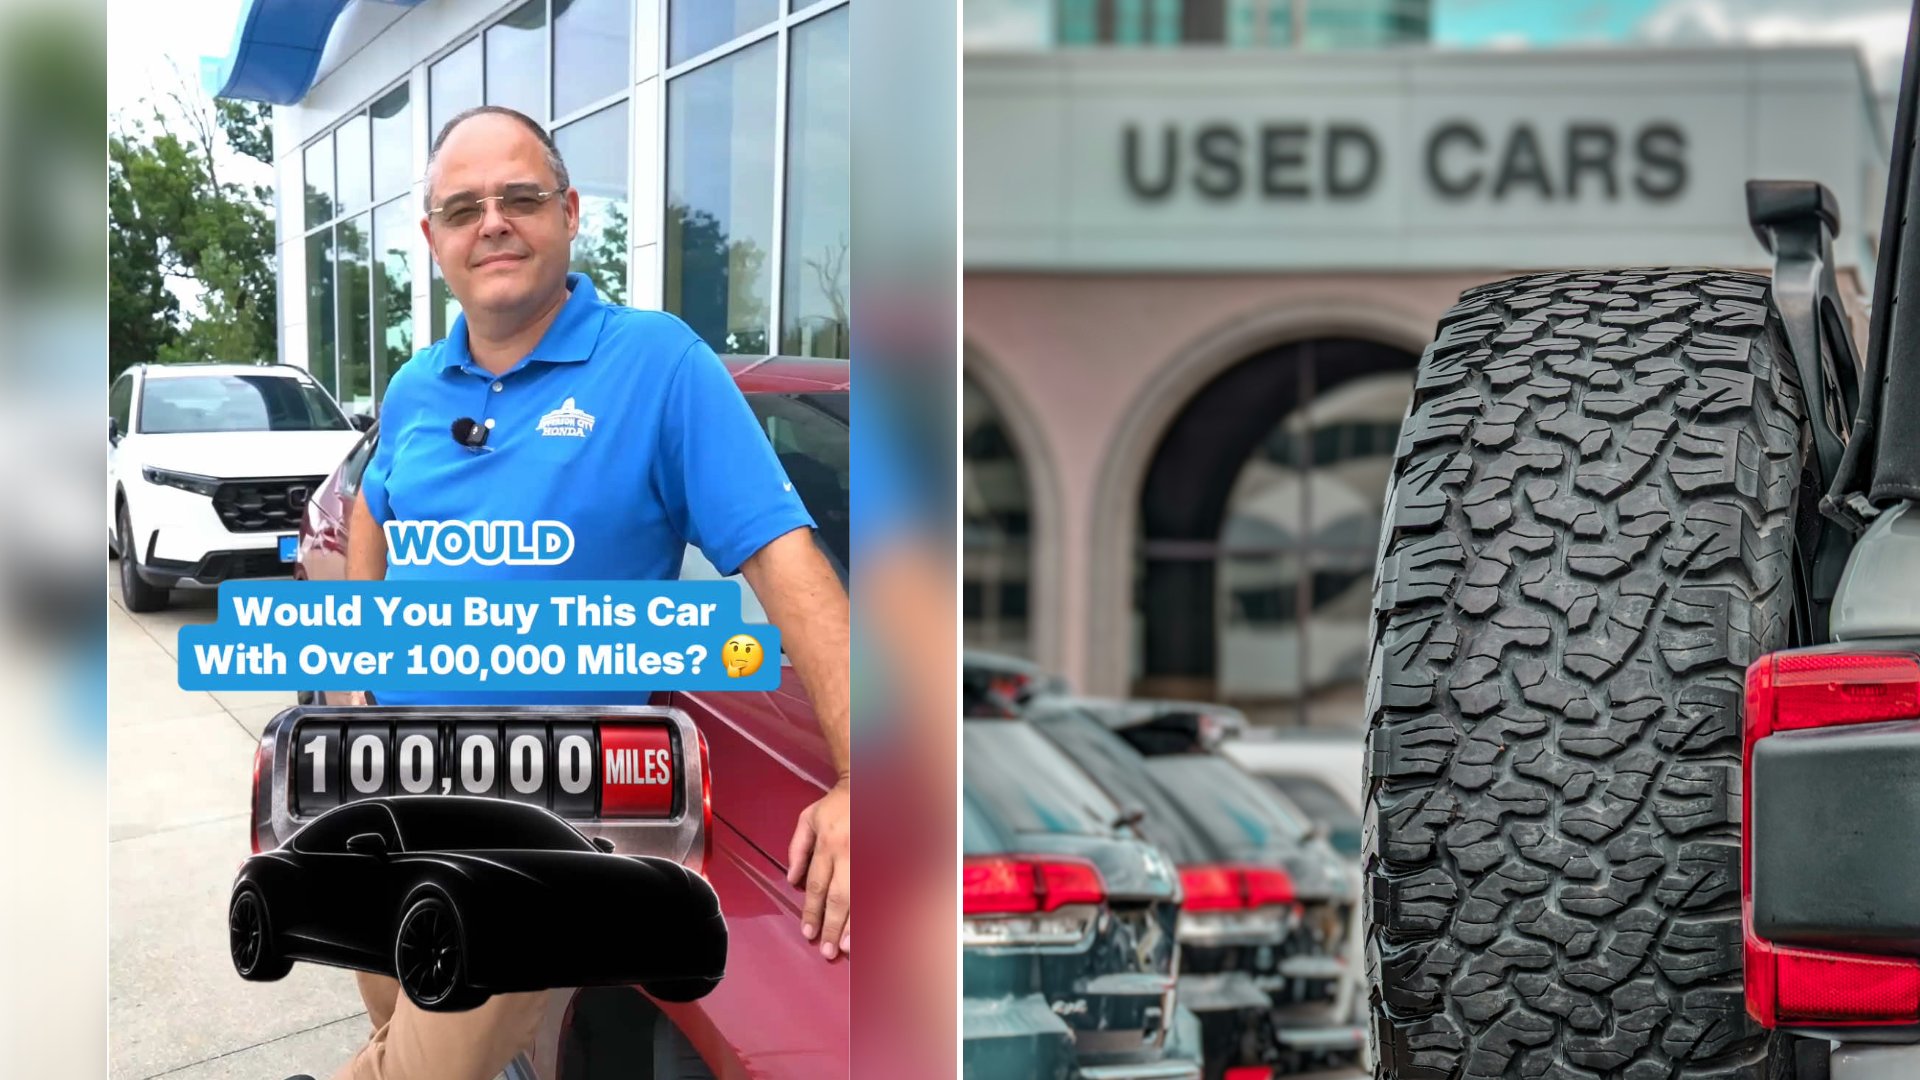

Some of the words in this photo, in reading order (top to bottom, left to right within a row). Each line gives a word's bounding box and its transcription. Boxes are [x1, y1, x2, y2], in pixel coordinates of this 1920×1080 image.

[1121, 121, 1383, 204] USED
[1423, 119, 1691, 204] CARS
[542, 427, 585, 437] HONDA
